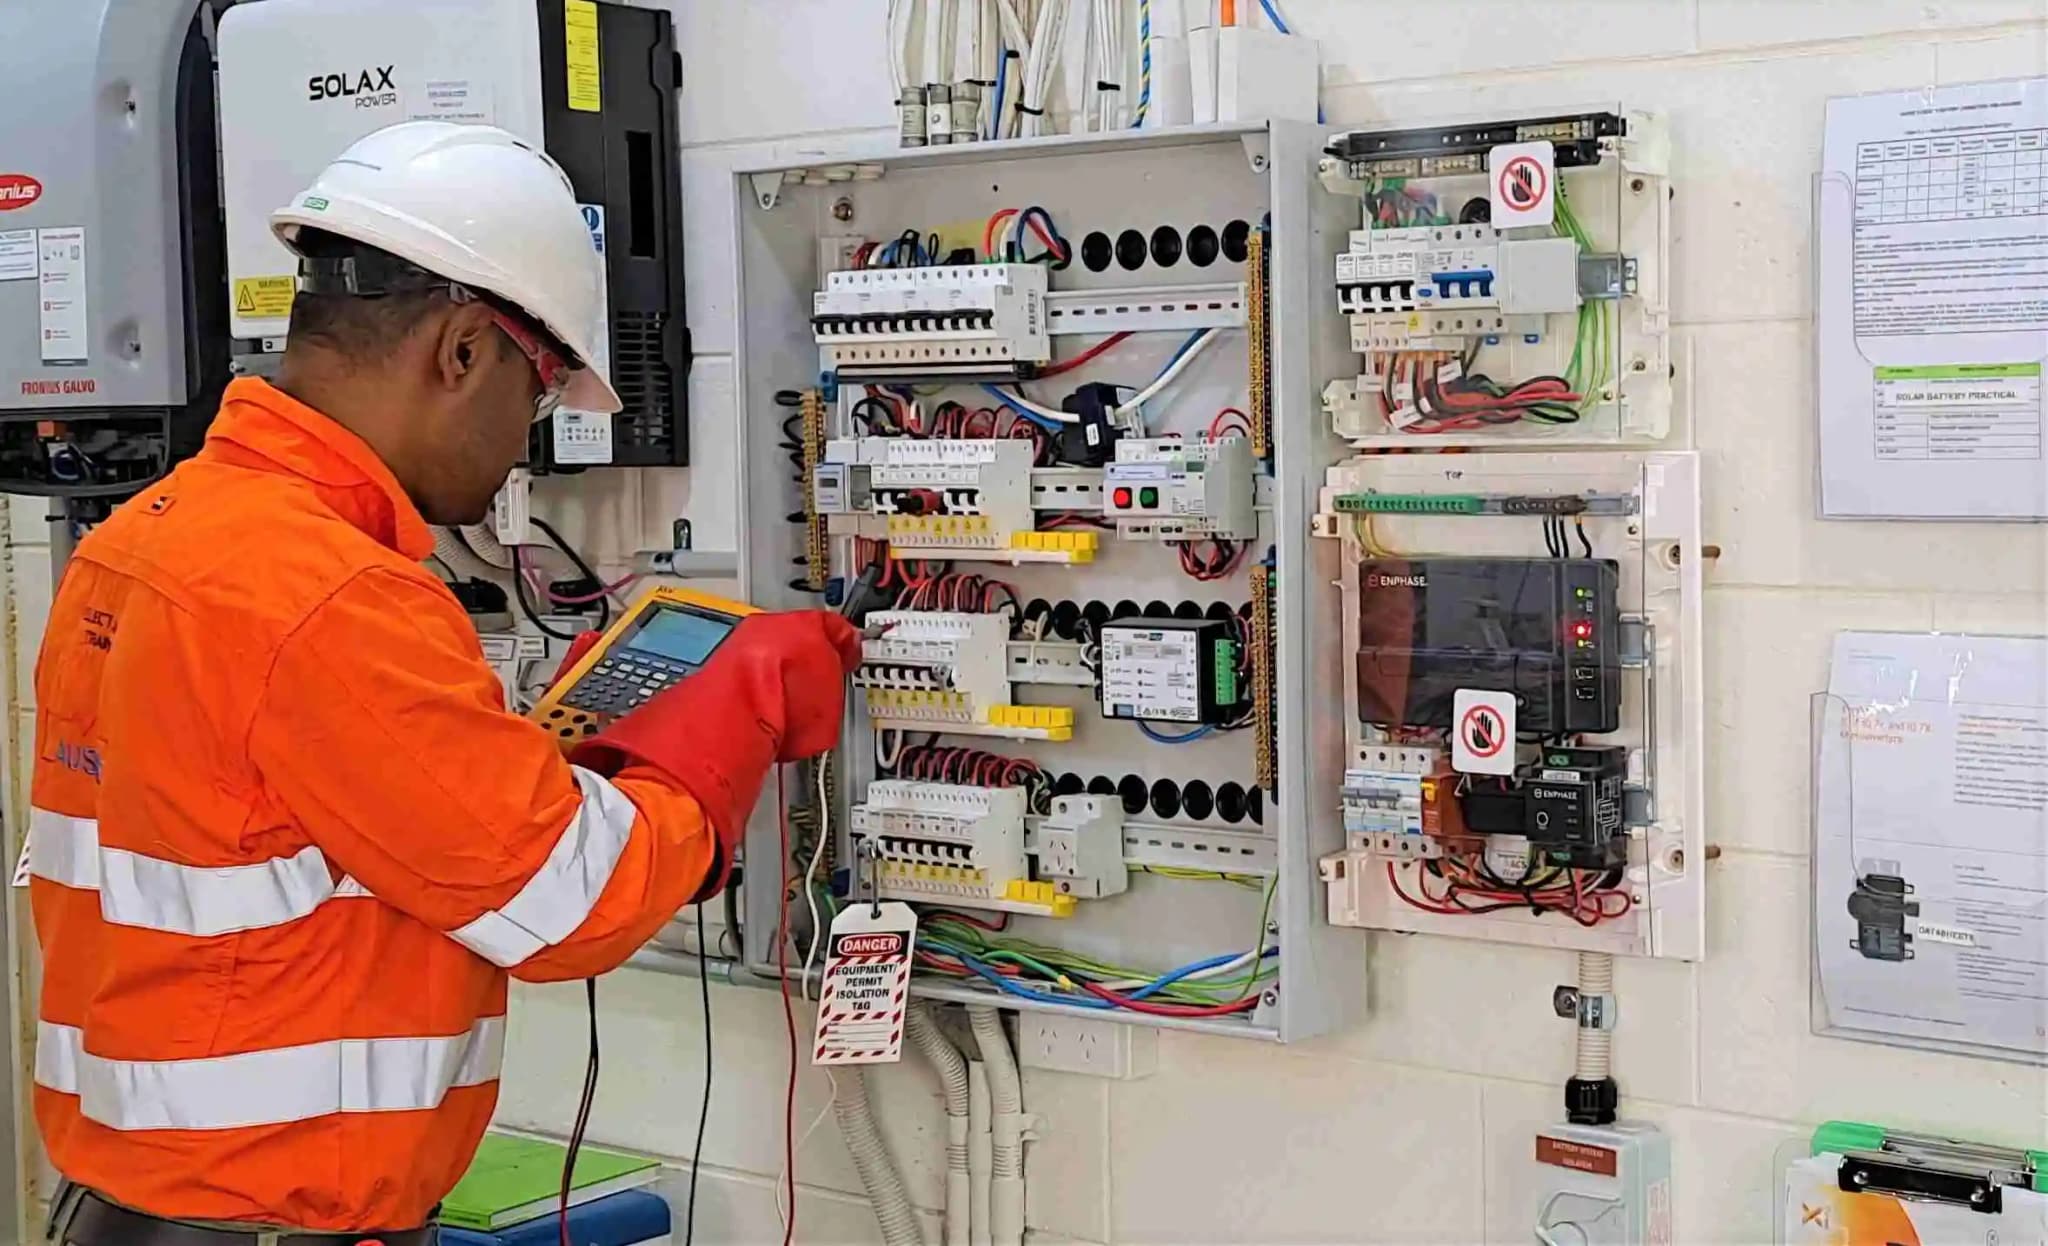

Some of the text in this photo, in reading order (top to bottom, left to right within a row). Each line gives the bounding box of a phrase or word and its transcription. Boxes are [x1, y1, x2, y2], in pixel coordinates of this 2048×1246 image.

[309, 65, 395, 101] SOLAX
[355, 93, 397, 109] POWER
[63, 379, 96, 394] GALVO
[842, 937, 899, 953] DANGER
[845, 976, 884, 987] PERMIT
[836, 987, 890, 1000] ISOLATION
[852, 1001, 871, 1011] TAG
